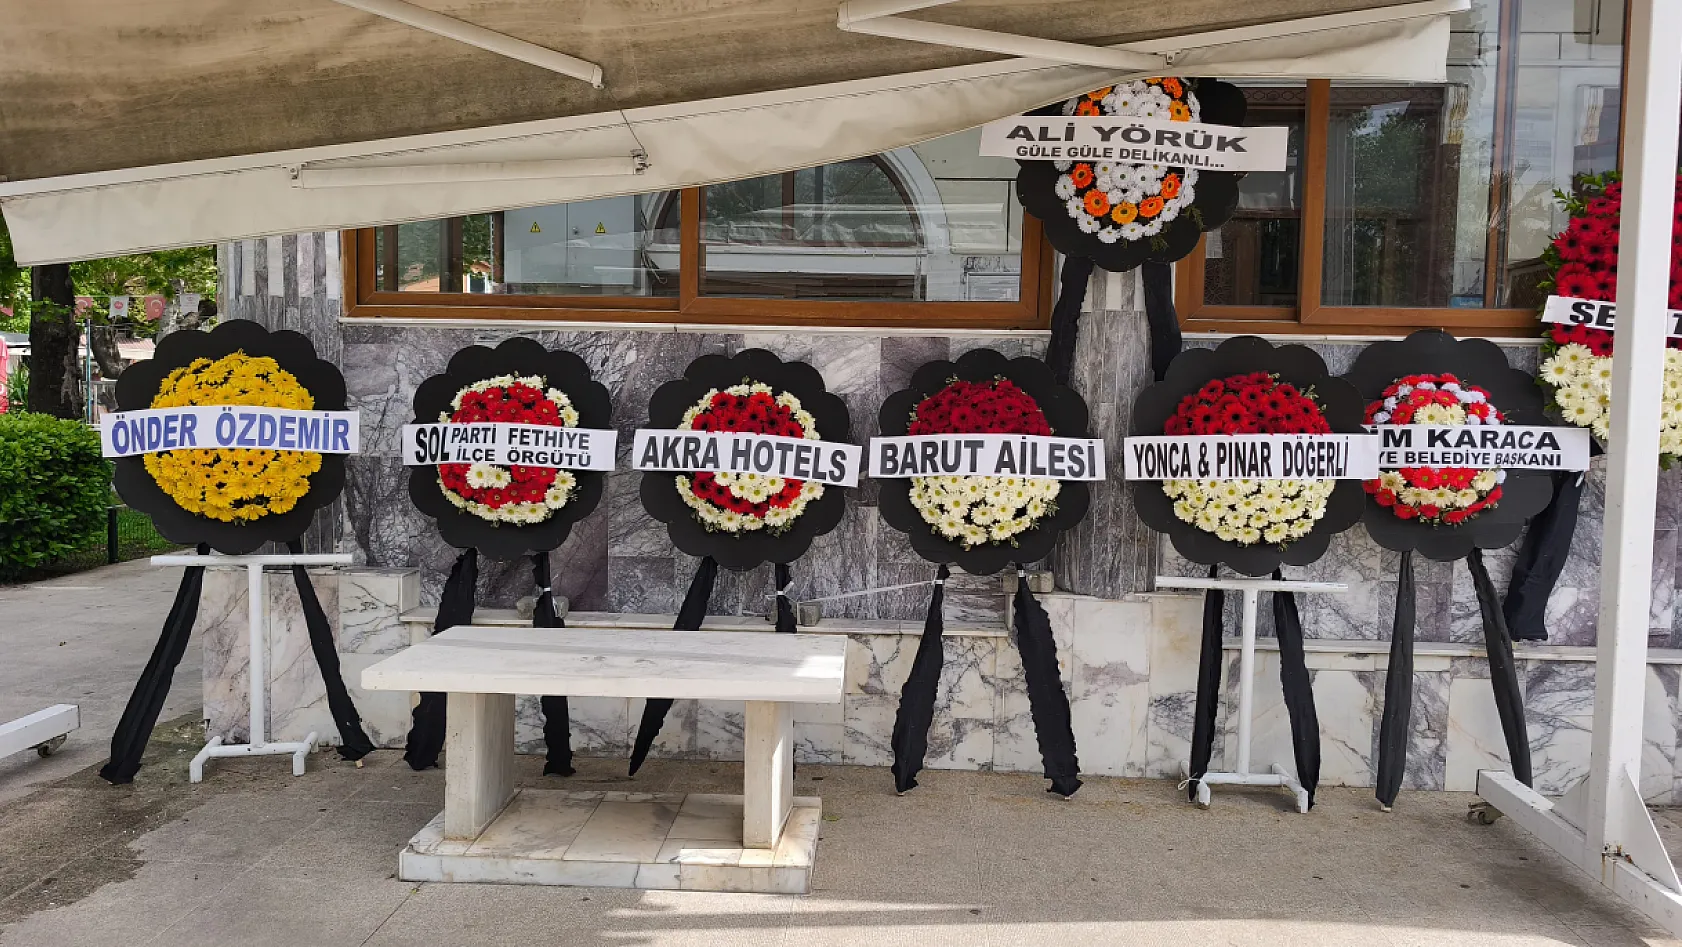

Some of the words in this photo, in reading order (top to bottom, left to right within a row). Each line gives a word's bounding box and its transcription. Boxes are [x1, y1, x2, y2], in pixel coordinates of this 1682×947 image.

[1006, 122, 1075, 142] ALİ
[1091, 123, 1248, 153] YÖRÜK
[1016, 144, 1062, 157] GÜLE
[1067, 144, 1114, 158] GÜLE
[111, 414, 198, 455] ÖNDER
[215, 406, 350, 451] ÖZDEMİR
[415, 426, 450, 463] SOL
[451, 423, 497, 444] PARTİ
[508, 427, 590, 450] FETHİYE
[1383, 428, 1412, 448] M
[1427, 428, 1561, 451] KARACA
[456, 446, 496, 463] İLÇE
[507, 446, 592, 468] ÖRGÜTÜ
[640, 435, 720, 469] AKRA
[730, 438, 847, 483] HOTELS
[879, 439, 984, 476] BARUT
[994, 435, 1096, 478] AİLESİ
[1133, 442, 1192, 478] YONCA
[1198, 441, 1211, 477] &
[1216, 440, 1273, 477] PINAR
[1282, 435, 1349, 478] DÖĞERLİ
[1405, 449, 1491, 466] BELEDİYE
[1494, 452, 1562, 467] BAŞKANI
